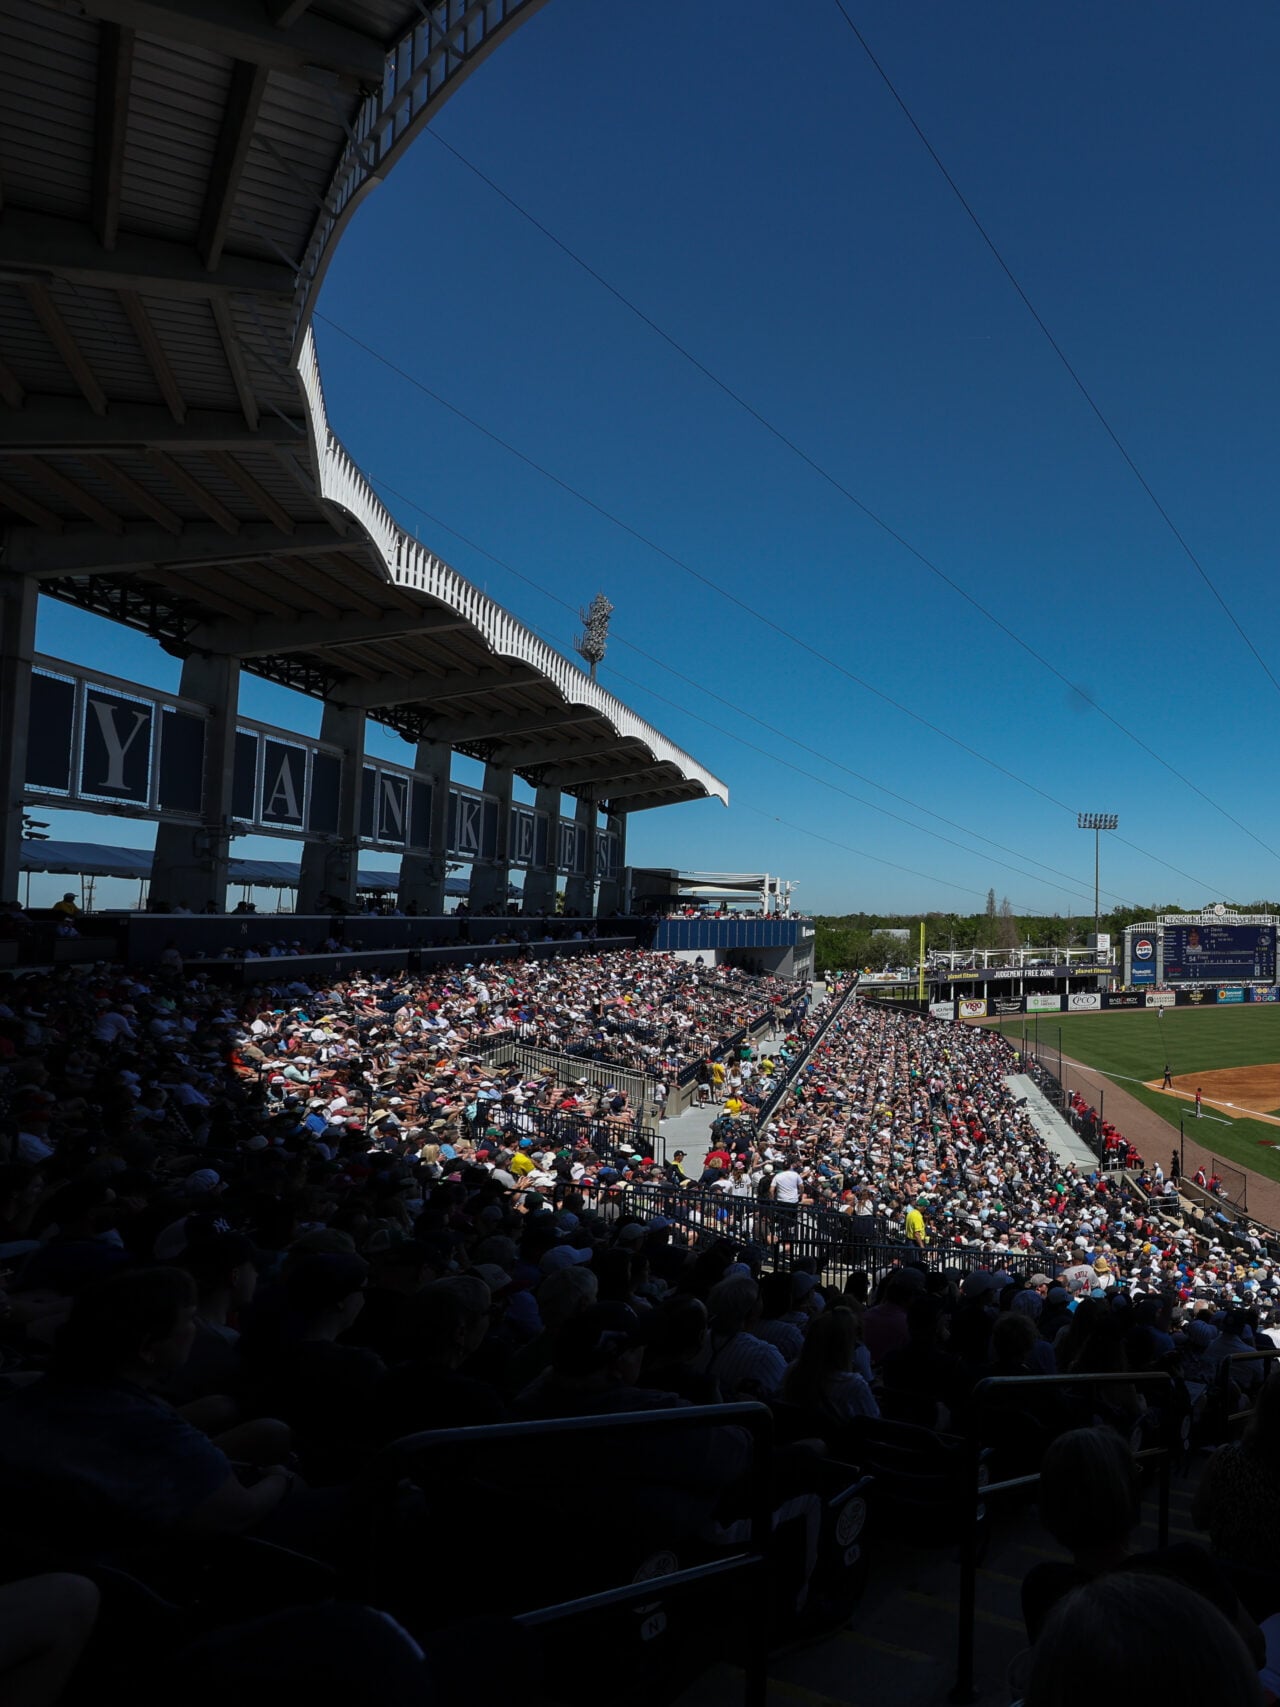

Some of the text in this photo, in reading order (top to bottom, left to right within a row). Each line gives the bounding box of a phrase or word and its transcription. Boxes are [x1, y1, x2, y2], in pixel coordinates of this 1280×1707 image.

[947, 973, 962, 981] planet
[994, 969, 1055, 978] JUDGEMENT FREE ZONE
[1076, 996, 1095, 1004] PCC
